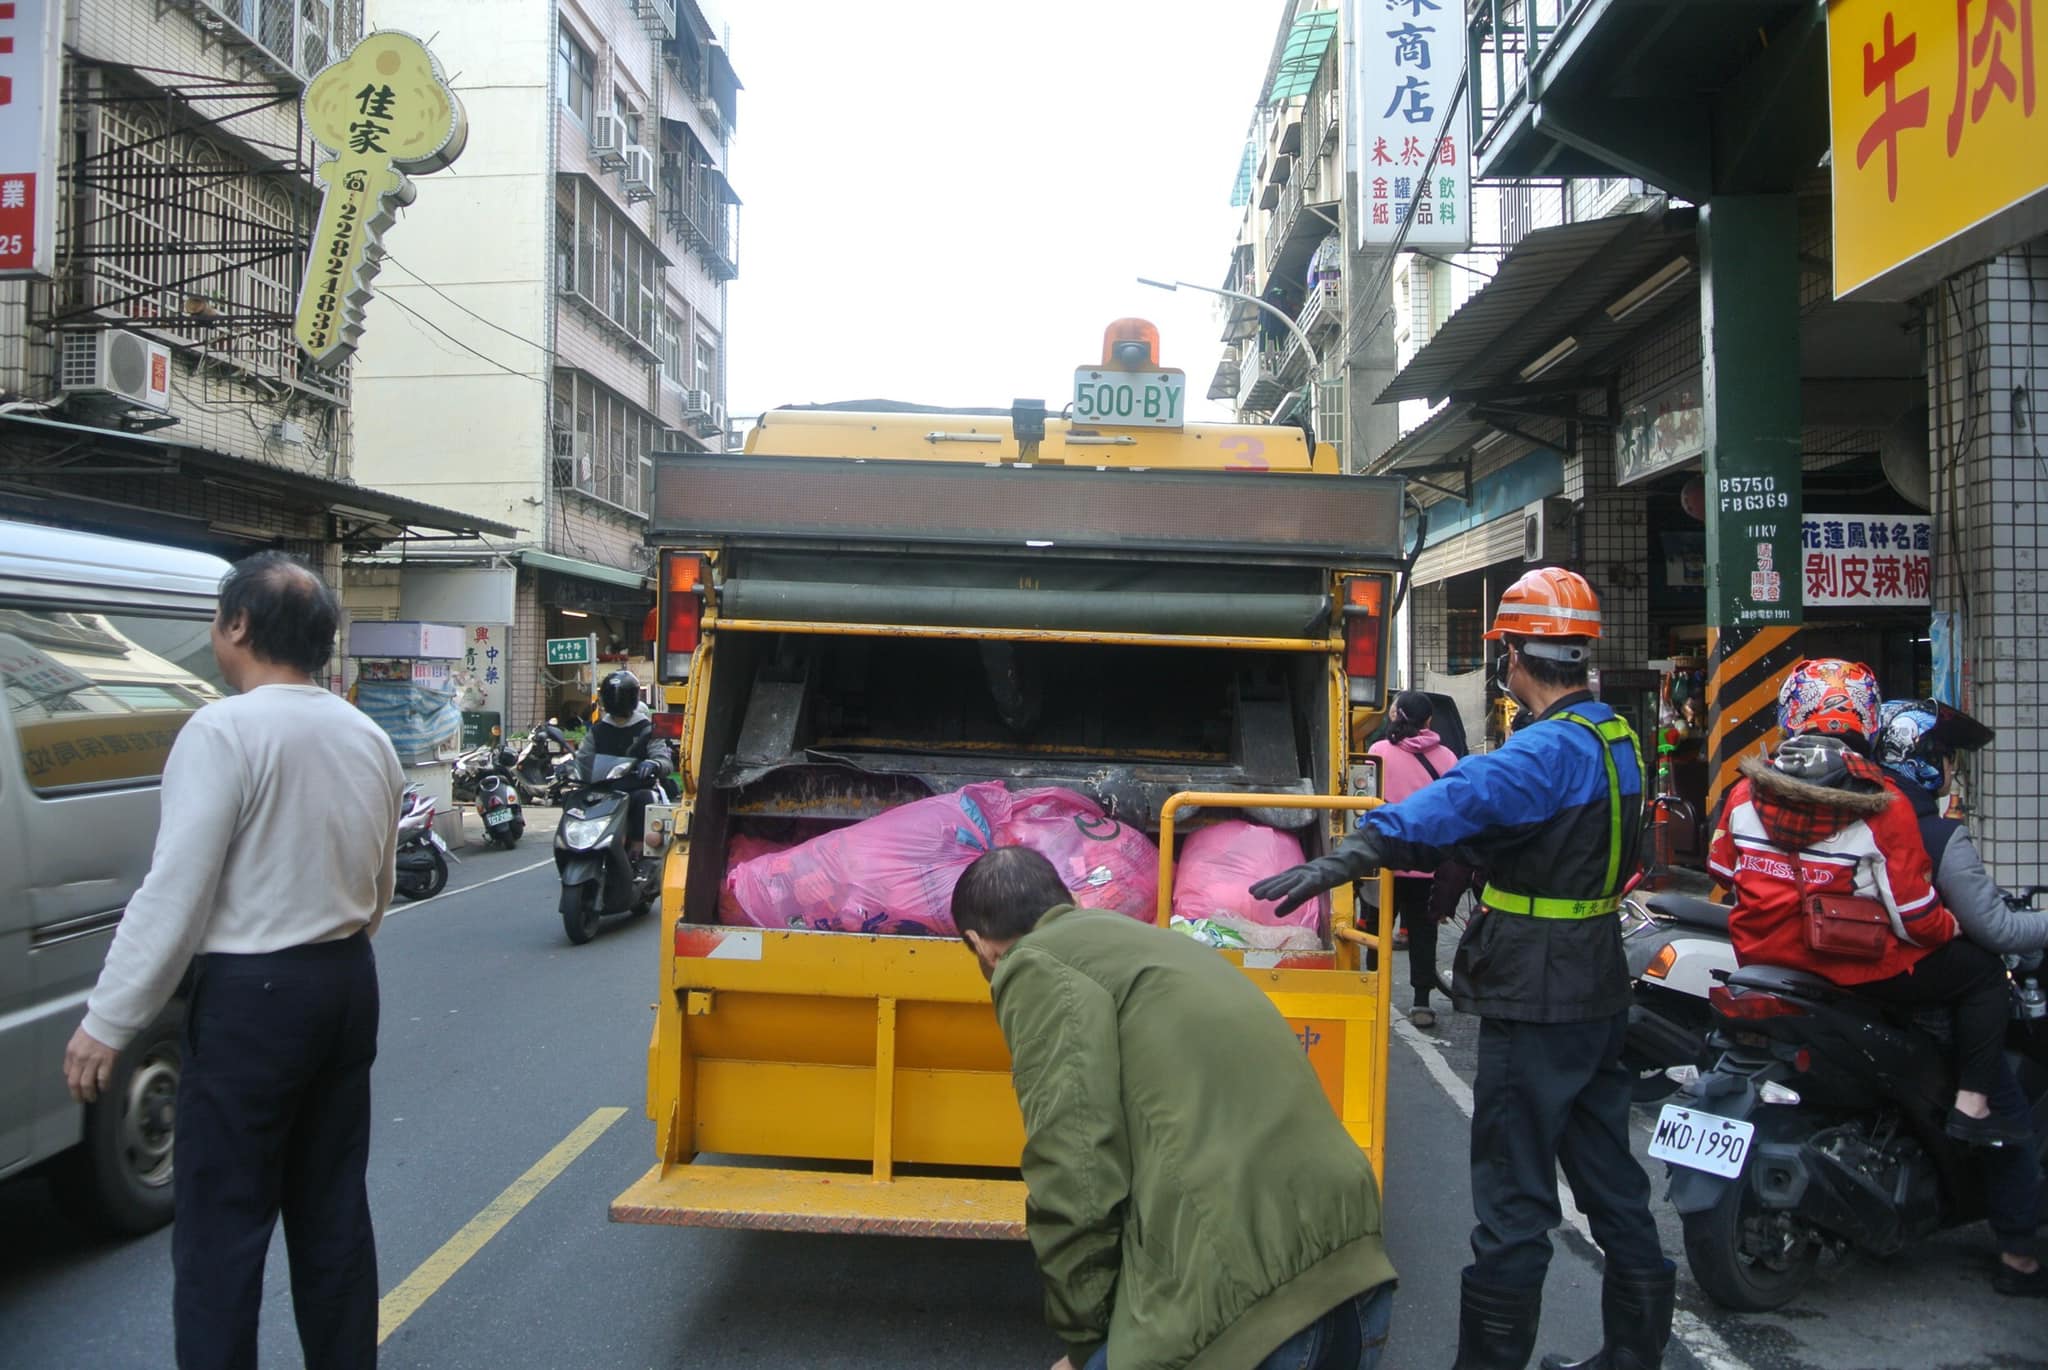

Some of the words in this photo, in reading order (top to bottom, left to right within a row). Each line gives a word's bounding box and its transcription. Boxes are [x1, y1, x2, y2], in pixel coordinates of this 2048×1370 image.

[349, 83, 398, 155] 佳家
[1077, 383, 1181, 419] 500-BY
[1720, 477, 1775, 493] B5750
[1721, 492, 1788, 513] FB6369
